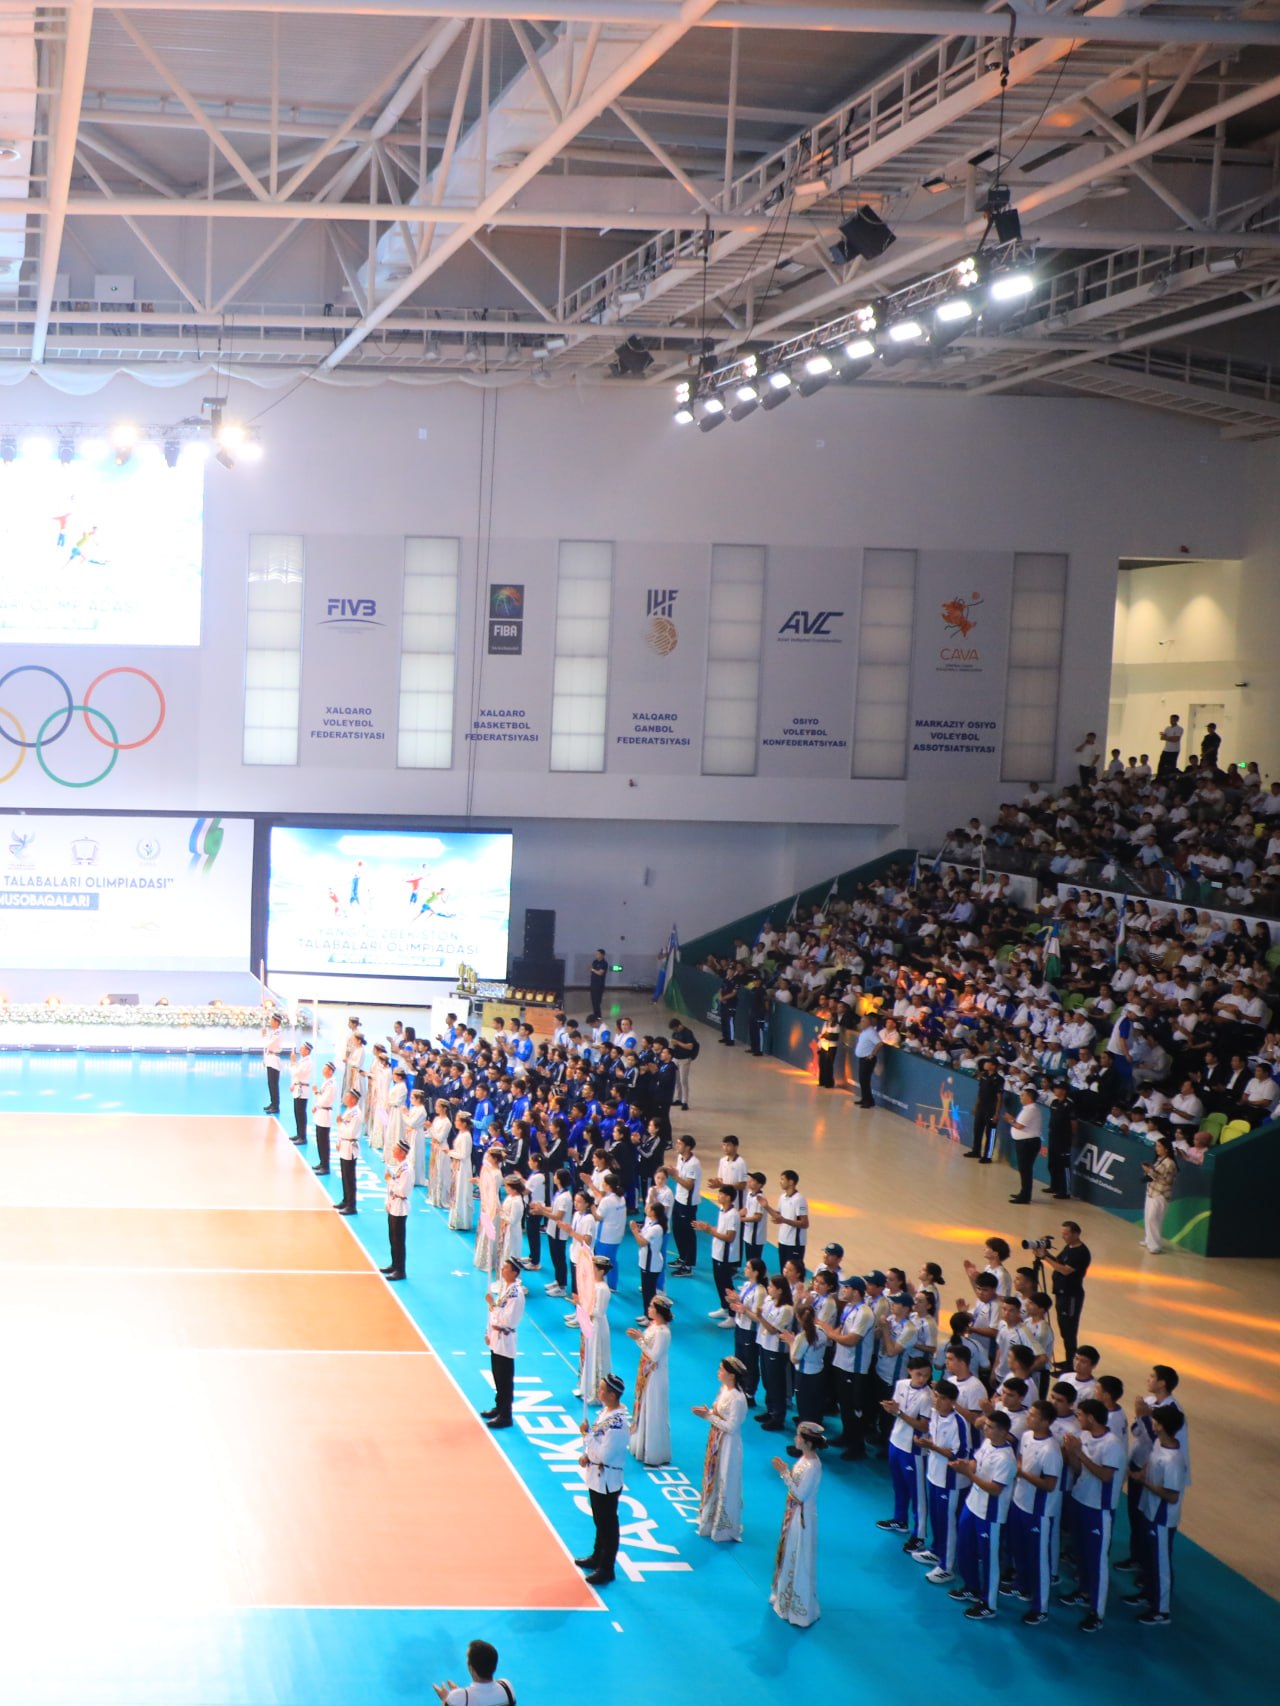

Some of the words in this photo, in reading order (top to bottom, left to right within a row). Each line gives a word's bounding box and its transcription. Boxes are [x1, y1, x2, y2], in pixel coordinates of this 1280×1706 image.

[328, 598, 376, 616] FIVB
[647, 589, 679, 618] IHF
[778, 611, 844, 634] AVC
[493, 625, 517, 637] FIBA
[940, 648, 979, 661] CAVA
[325, 706, 372, 716] XALQARO
[479, 709, 526, 718] XALQARO
[632, 712, 678, 720] XALQARO
[323, 718, 374, 727] VOLEYBOL
[473, 721, 531, 730] BASKETBOL
[915, 720, 964, 728] MARKAZIY
[967, 721, 996, 729] OSIYO
[310, 730, 385, 740] FEDERATSIYASI
[783, 728, 828, 736] VOLEYBOL
[930, 732, 980, 741] VOLEYBOL
[465, 733, 539, 742] FEDERATSIYASI
[617, 736, 690, 745] FEDERATSIYASI
[762, 739, 847, 748] KONFEDERATSIYASI
[913, 744, 995, 753] ASSOTSIATSIYASI
[4, 875, 81, 887] TALABALARI
[1074, 1143, 1126, 1181] AVC
